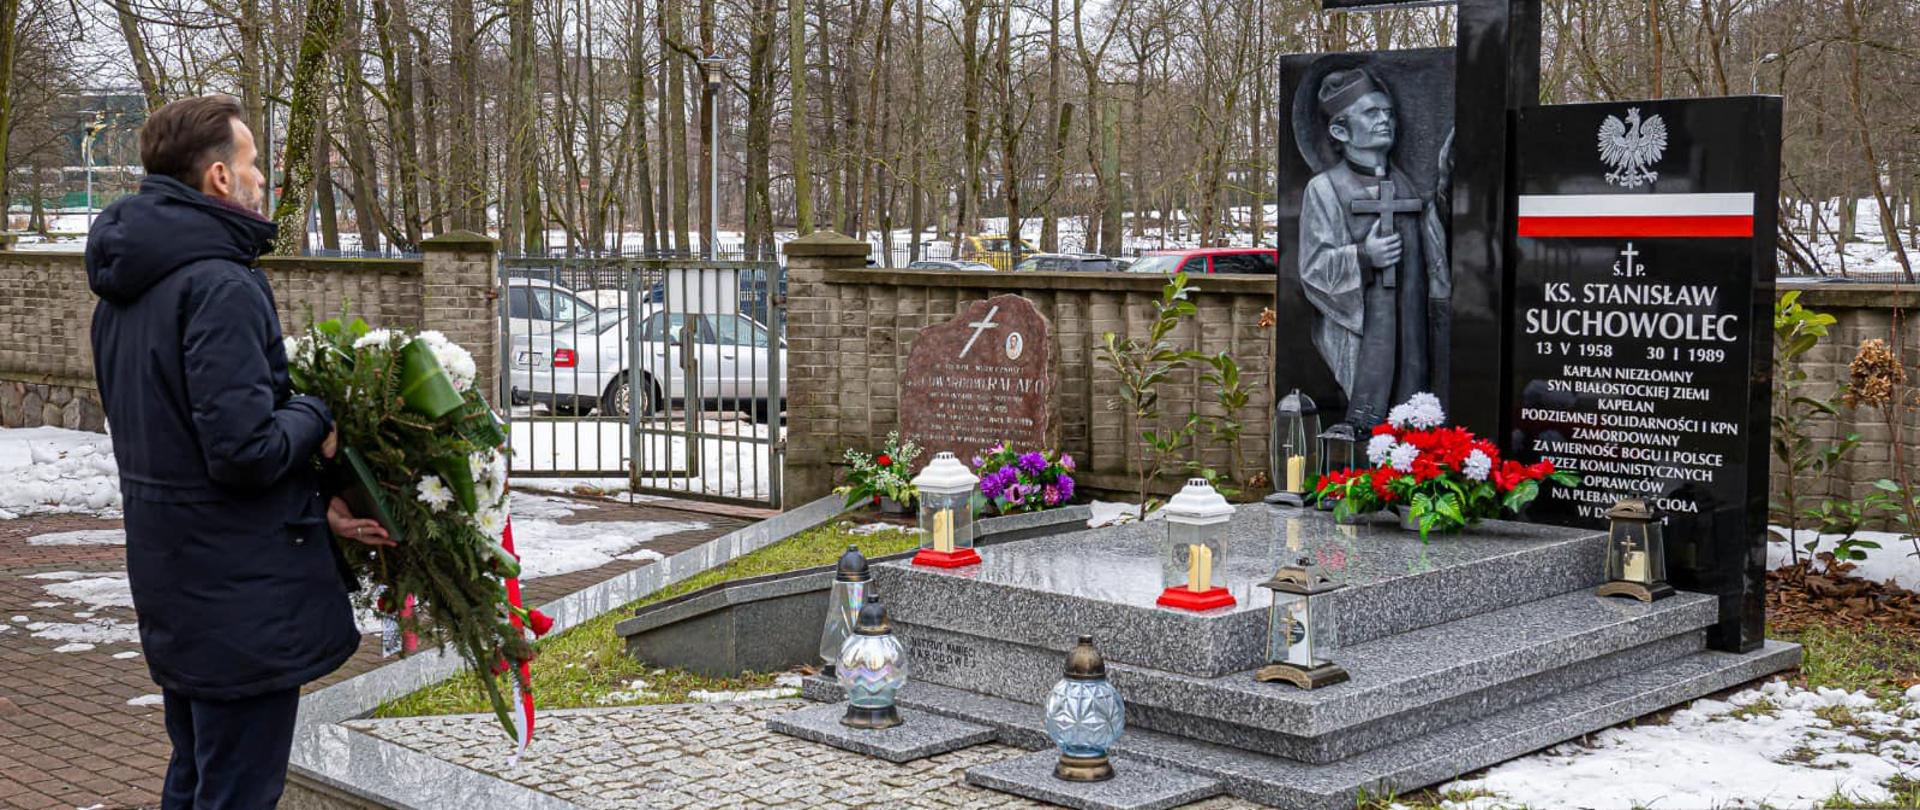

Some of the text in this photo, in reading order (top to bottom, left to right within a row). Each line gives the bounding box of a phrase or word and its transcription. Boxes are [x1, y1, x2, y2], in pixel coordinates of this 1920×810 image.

[1636, 264, 1646, 277] P.
[1544, 282, 1718, 307] KS. STANISŁAW
[1525, 308, 1739, 342] SUCHOWOLEC
[1536, 341, 1725, 363] 13 V 1958 30 I 1989
[1563, 365, 1694, 384] KAPŁAN NIEZŁOMNY
[1547, 379, 1710, 401] SYN BIAŁOSTOCKIEJ ZIEMI
[1598, 399, 1655, 414] KAPELAN
[1521, 408, 1739, 436] PODZIEMNEJ SOLIDARNOŚCI I KPN
[1571, 427, 1681, 447] ZAMORDOWANY
[1533, 439, 1550, 452] ZA
[1551, 441, 1619, 459] WIERNOŚĆ
[1621, 447, 1662, 463] BOGU
[1672, 451, 1723, 467] POLSCE
[1580, 459, 1713, 483] KOMUNISTYCZNYCH
[1552, 487, 1570, 500] NA
[1584, 474, 1665, 494] OPRAWCÓW
[1578, 505, 1591, 518] W
